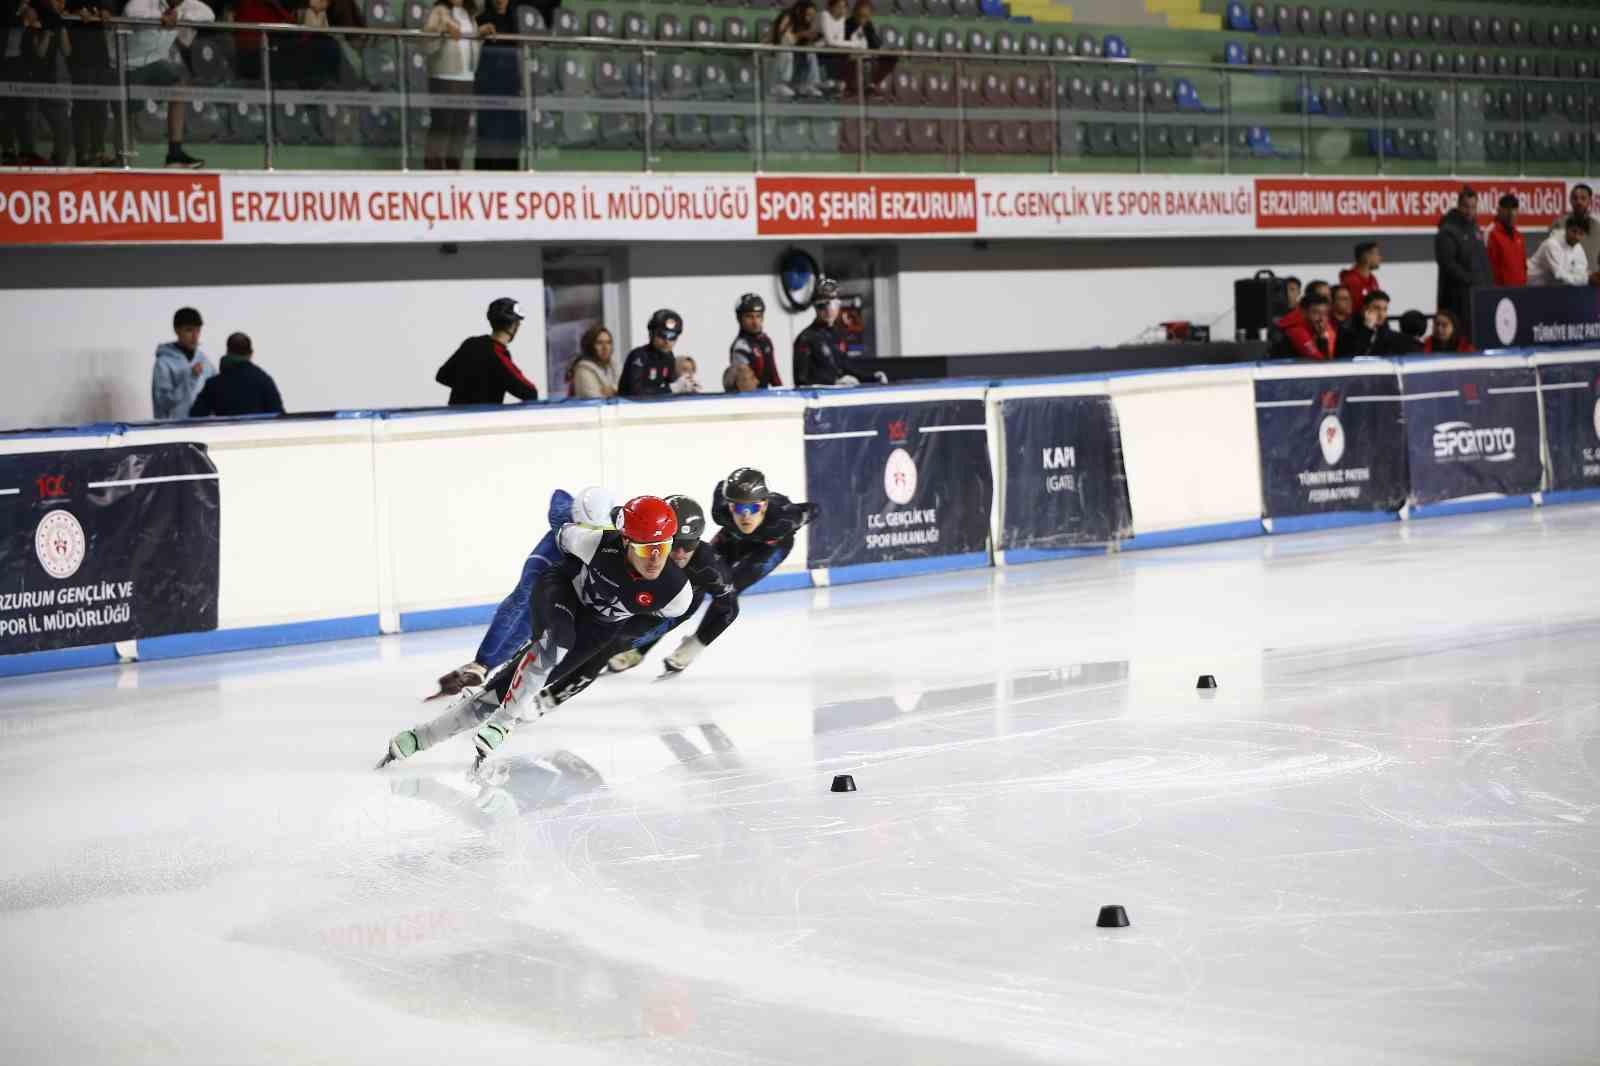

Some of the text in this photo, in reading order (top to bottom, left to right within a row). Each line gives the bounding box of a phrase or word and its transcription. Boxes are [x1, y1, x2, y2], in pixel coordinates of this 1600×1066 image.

[58, 183, 217, 225] BAKANLIĞI
[231, 185, 750, 230] ERZURUM GENÇLİK VE SPOR İL MÜDÜRLÜĞÜ
[759, 186, 975, 227] SPOR ŞEHRİ ERZURUM
[1092, 191, 1113, 216] VE
[1118, 191, 1161, 217] SPOR
[1166, 186, 1252, 216] BAKANLIĞI
[1259, 190, 1335, 217] ERZURUM
[1337, 186, 1400, 223] GENÇLİK
[1401, 190, 1421, 216] VE
[57, 580, 116, 607] GENÇLİK
[117, 581, 134, 599] VE
[28, 613, 42, 634] İL
[43, 602, 131, 632] MÜDÜRLÜĞÜ
